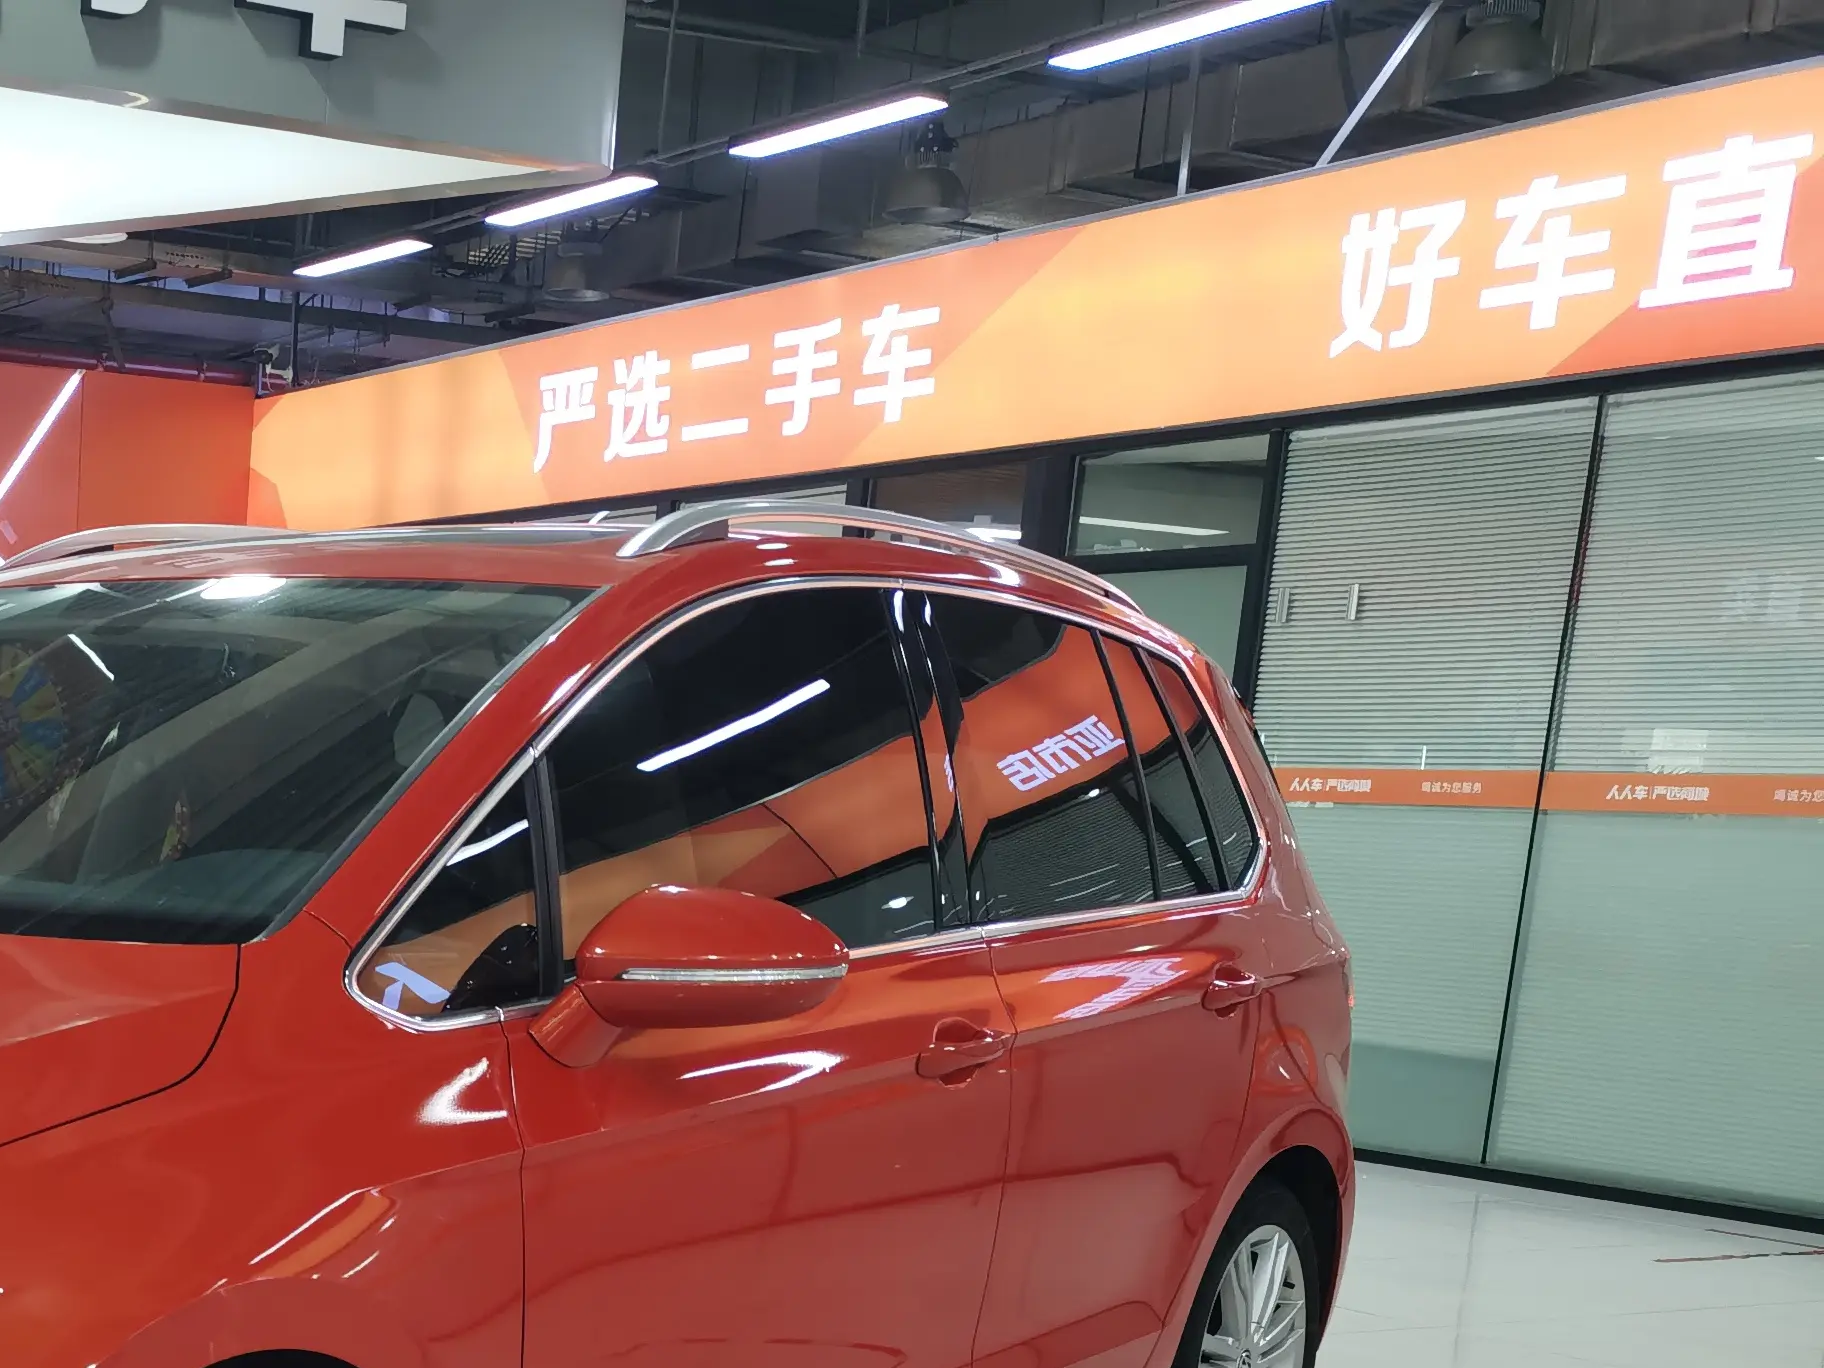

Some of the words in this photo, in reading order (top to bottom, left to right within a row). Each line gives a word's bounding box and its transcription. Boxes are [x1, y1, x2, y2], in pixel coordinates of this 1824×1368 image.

[1330, 132, 1814, 360] 好车直
[533, 303, 941, 474] 严选二手车
[1289, 777, 1323, 791] 人人车
[1605, 784, 1648, 800] 人人车
